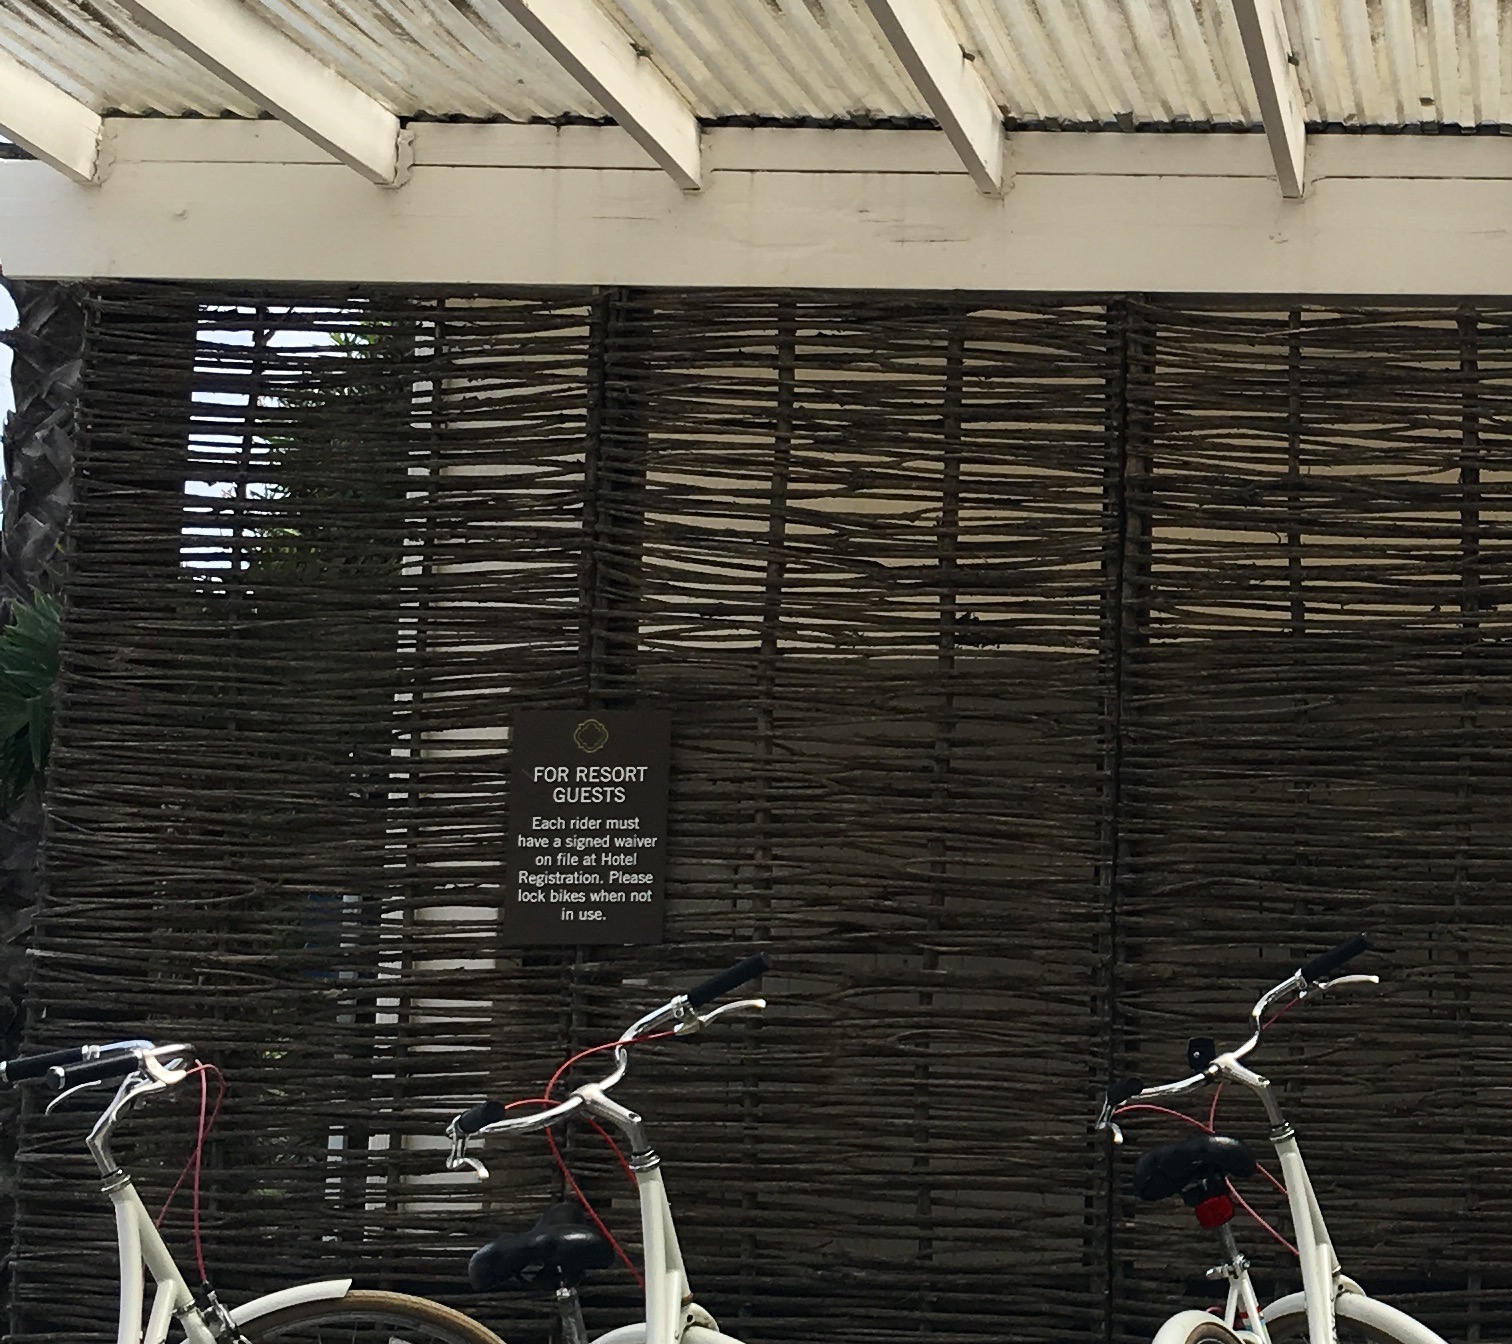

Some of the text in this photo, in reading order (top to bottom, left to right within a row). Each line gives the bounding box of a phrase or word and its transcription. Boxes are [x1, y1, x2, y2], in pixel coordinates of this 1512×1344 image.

[534, 767, 648, 782] FOR RESORT
[553, 787, 625, 802] GUESTS
[533, 817, 639, 829] Each rider must
[518, 835, 657, 850] have a signed waiver
[536, 853, 637, 865] on file at Hotel
[519, 871, 653, 886] Registration. Please
[518, 889, 652, 902] lock bikes when not
[561, 908, 606, 920] in use.
